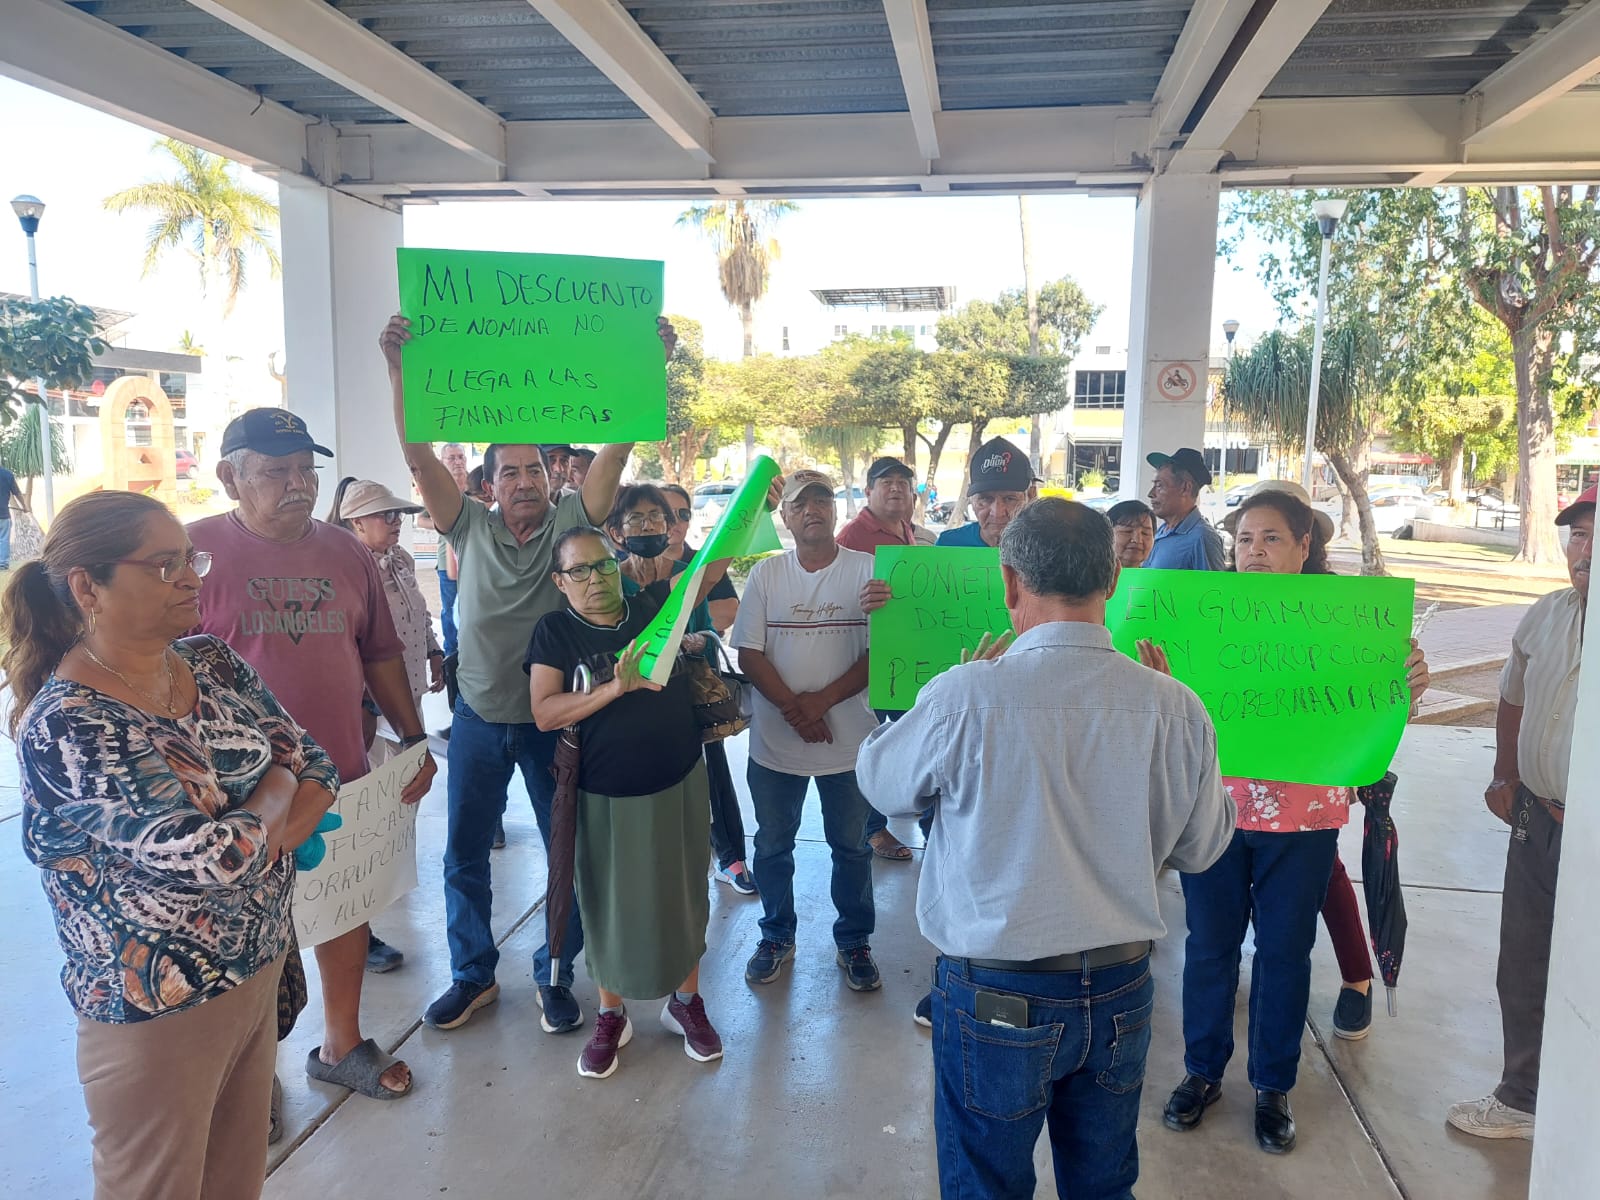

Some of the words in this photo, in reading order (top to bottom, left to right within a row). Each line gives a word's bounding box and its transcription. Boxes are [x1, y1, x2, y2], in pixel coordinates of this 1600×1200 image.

[423, 264, 474, 306] MI
[497, 269, 653, 307] DESCUENTO
[417, 314, 458, 336] DE
[467, 317, 550, 337] NOMINA
[574, 314, 604, 336] NO
[425, 368, 512, 395] LLEGA
[524, 370, 538, 389] A
[549, 367, 599, 389] LAS
[434, 405, 613, 430] FINANCIERAS
[247, 578, 336, 600] GUESS
[890, 560, 1001, 600] COMET
[1124, 586, 1180, 621] EN
[912, 607, 1011, 630] DELIT
[1218, 641, 1397, 672] CORRUPCION
[303, 819, 416, 902] ORRUPCION
